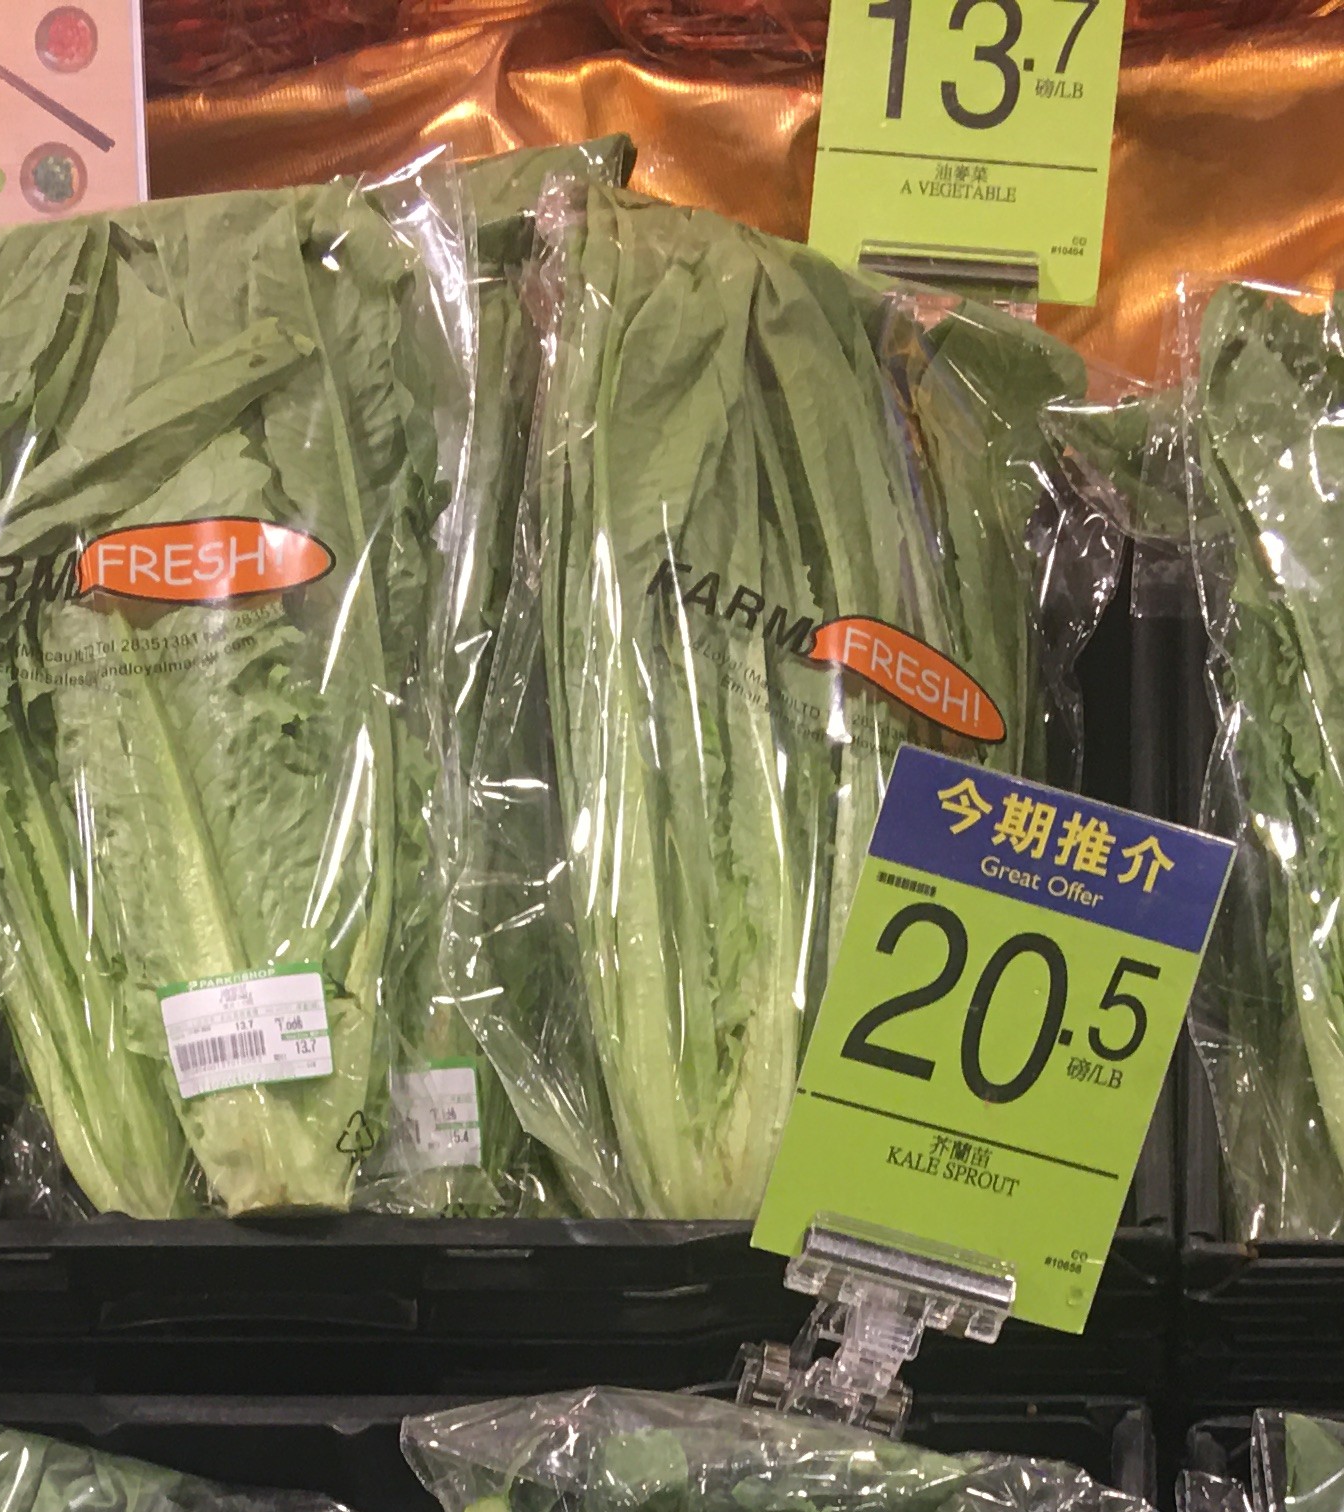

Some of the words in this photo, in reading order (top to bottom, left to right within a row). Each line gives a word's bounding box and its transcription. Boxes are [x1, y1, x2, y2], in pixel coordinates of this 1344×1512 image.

[868, 0, 1100, 130] 13.7
[900, 179, 912, 195] A
[919, 180, 1017, 203] VEGETABLE
[648, 559, 814, 654] FARM
[842, 626, 982, 728] FRESH!
[937, 777, 1176, 893] 今期推介
[980, 856, 1041, 891] Great
[1047, 875, 1105, 909] Offer
[840, 902, 1162, 1105] 20.5
[886, 1145, 939, 1178] KALE
[942, 1161, 1021, 1198] SPROUT
[928, 1135, 992, 1169] 芥蘭苗
